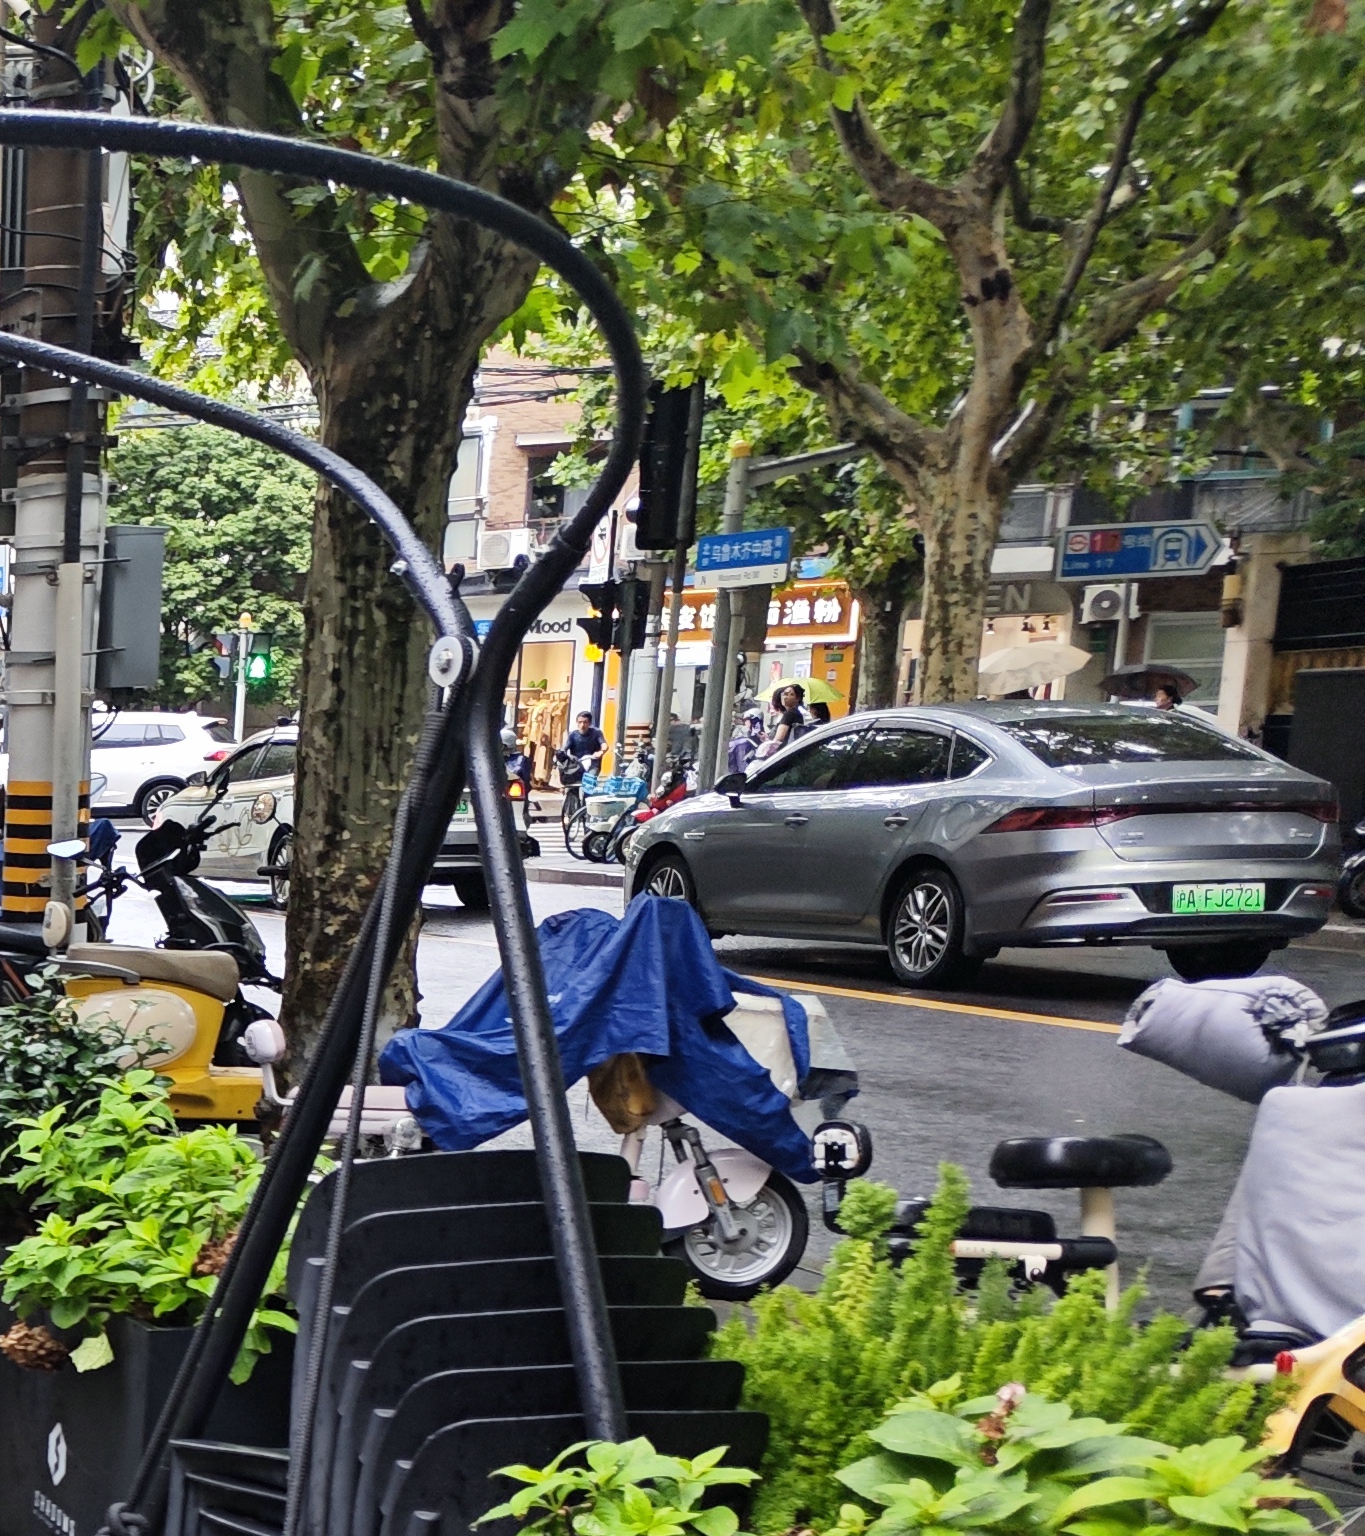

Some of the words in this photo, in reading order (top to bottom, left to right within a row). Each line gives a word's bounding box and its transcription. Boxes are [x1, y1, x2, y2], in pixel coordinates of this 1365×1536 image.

[712, 539, 773, 563] 乌鲁木齐中路
[1064, 561, 1090, 570] Line
